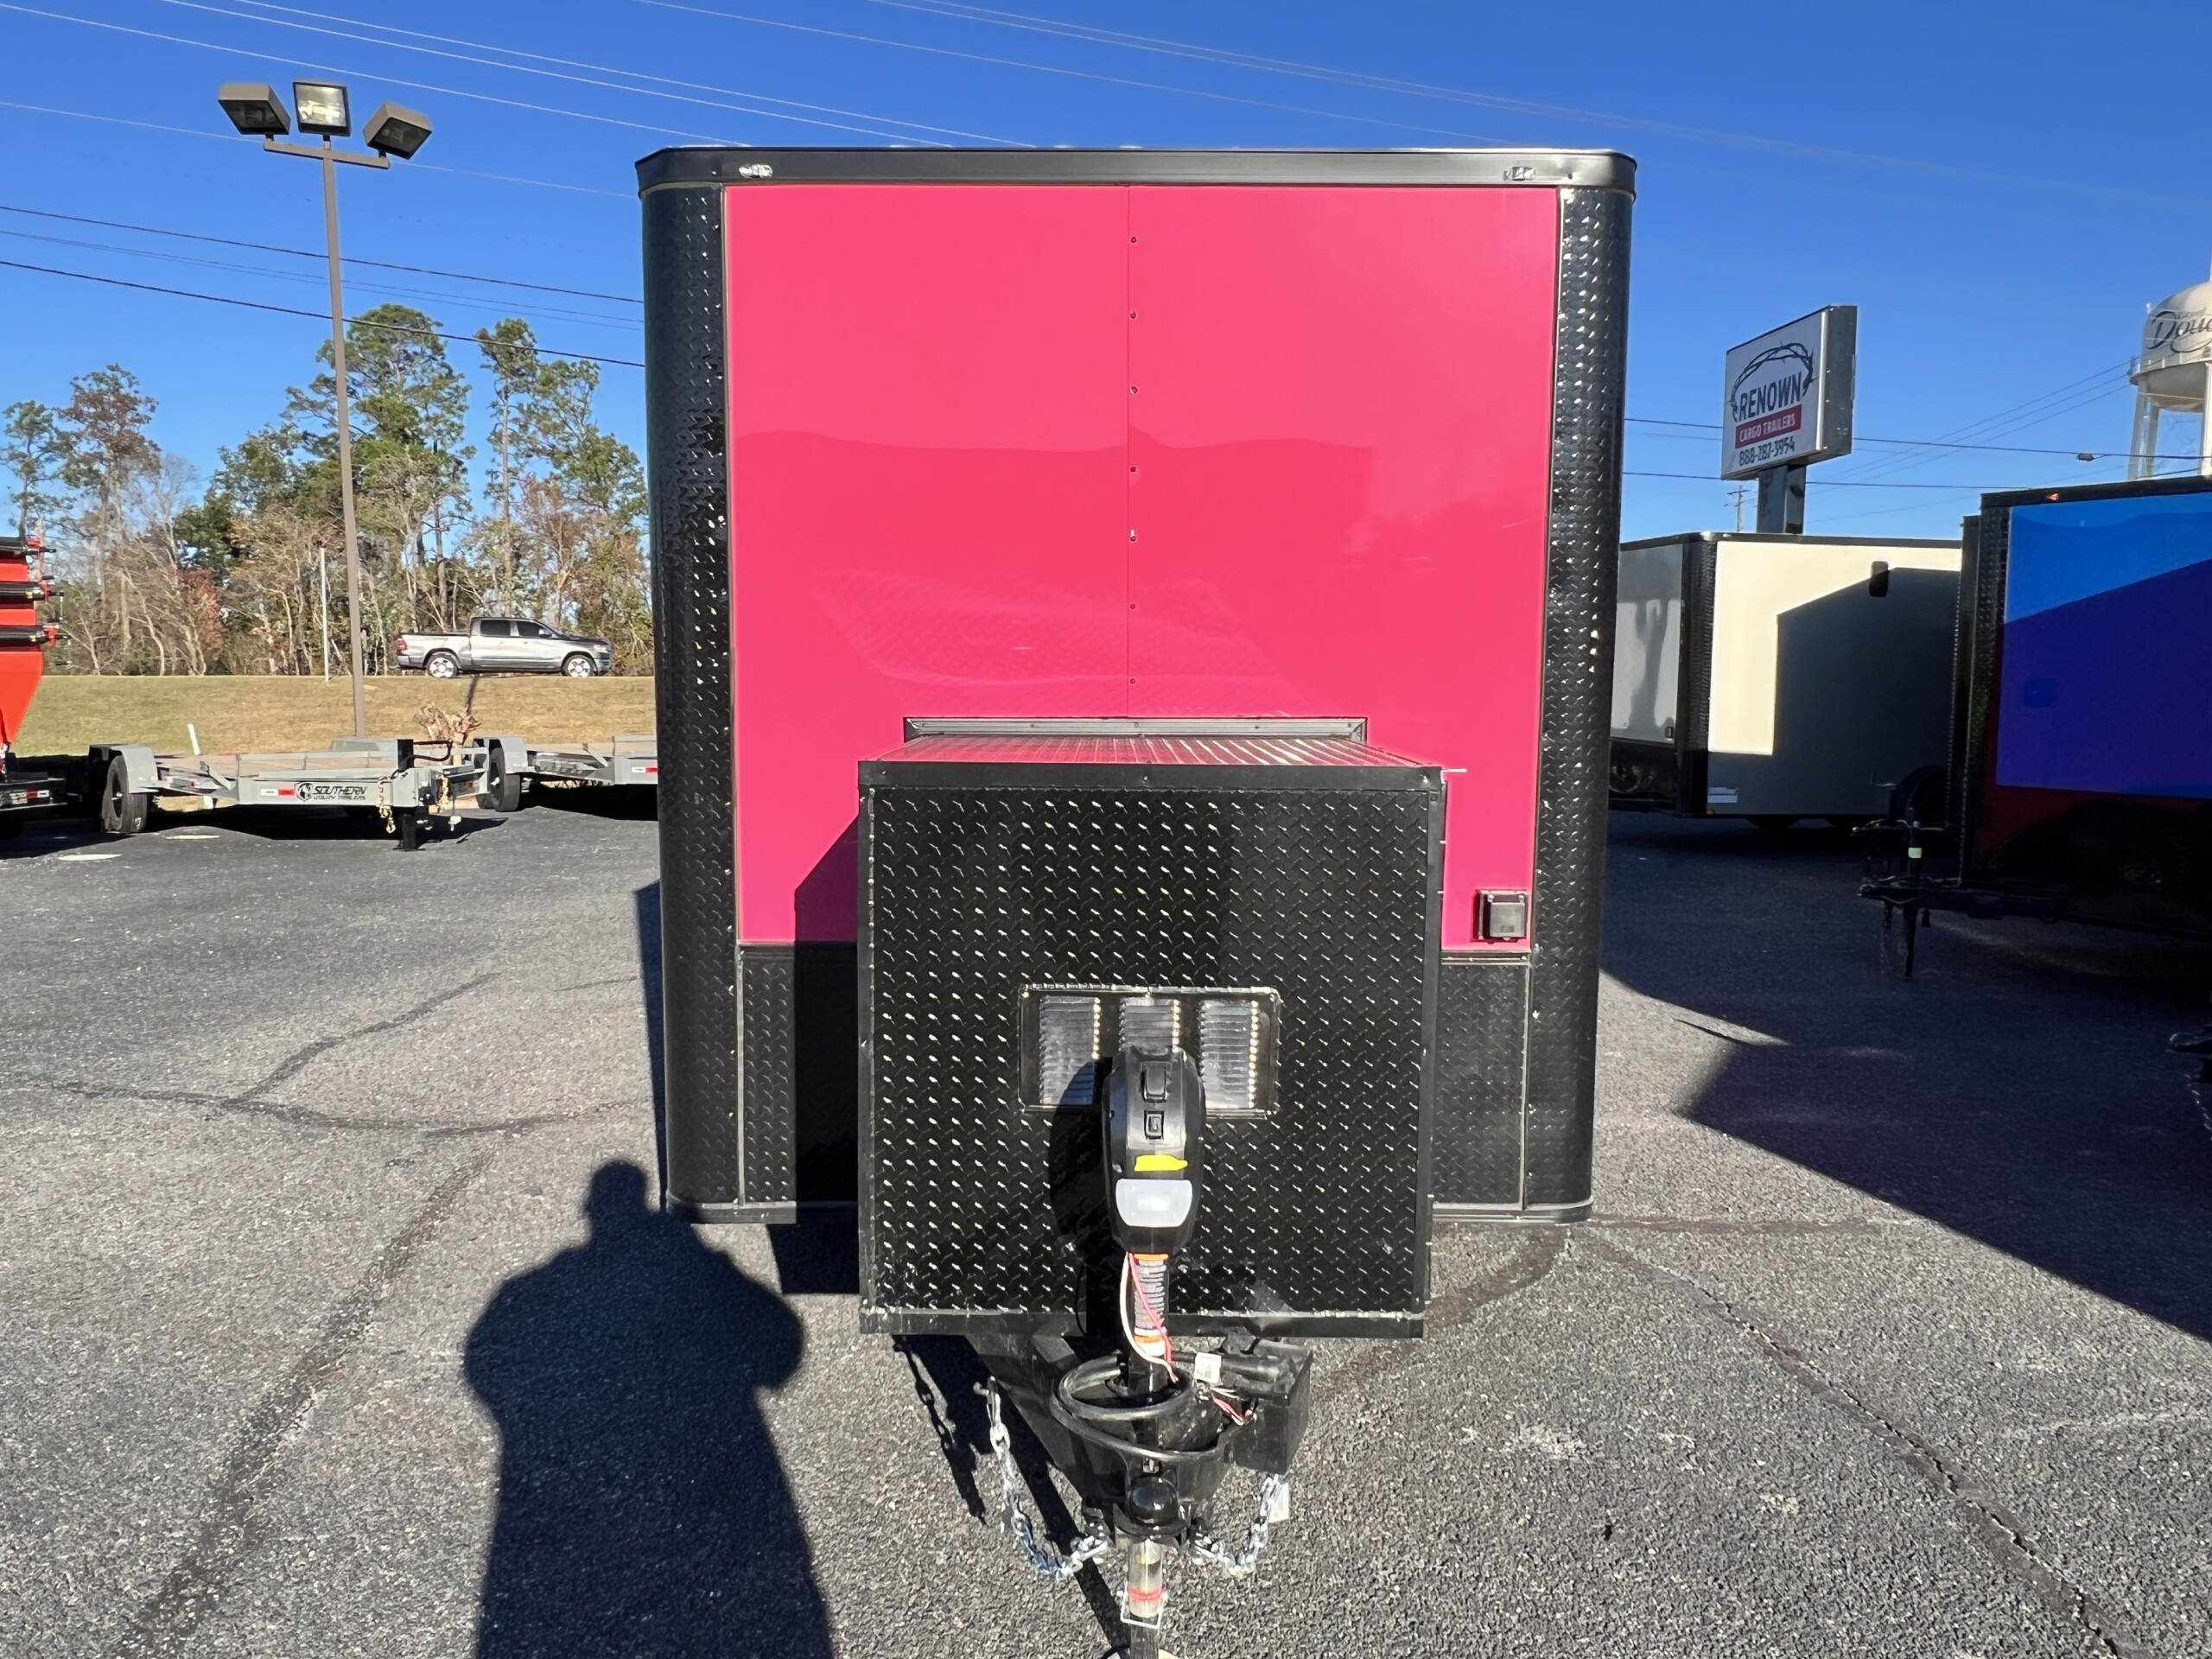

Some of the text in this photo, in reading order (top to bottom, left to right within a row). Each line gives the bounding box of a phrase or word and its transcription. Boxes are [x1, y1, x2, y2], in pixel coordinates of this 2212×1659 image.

[1738, 372, 1802, 422] RENOWN
[1739, 413, 1796, 442] CARGO TRAILERS
[1738, 435, 1795, 467] 888-787-3954
[313, 785, 367, 795] SOUTHERN
